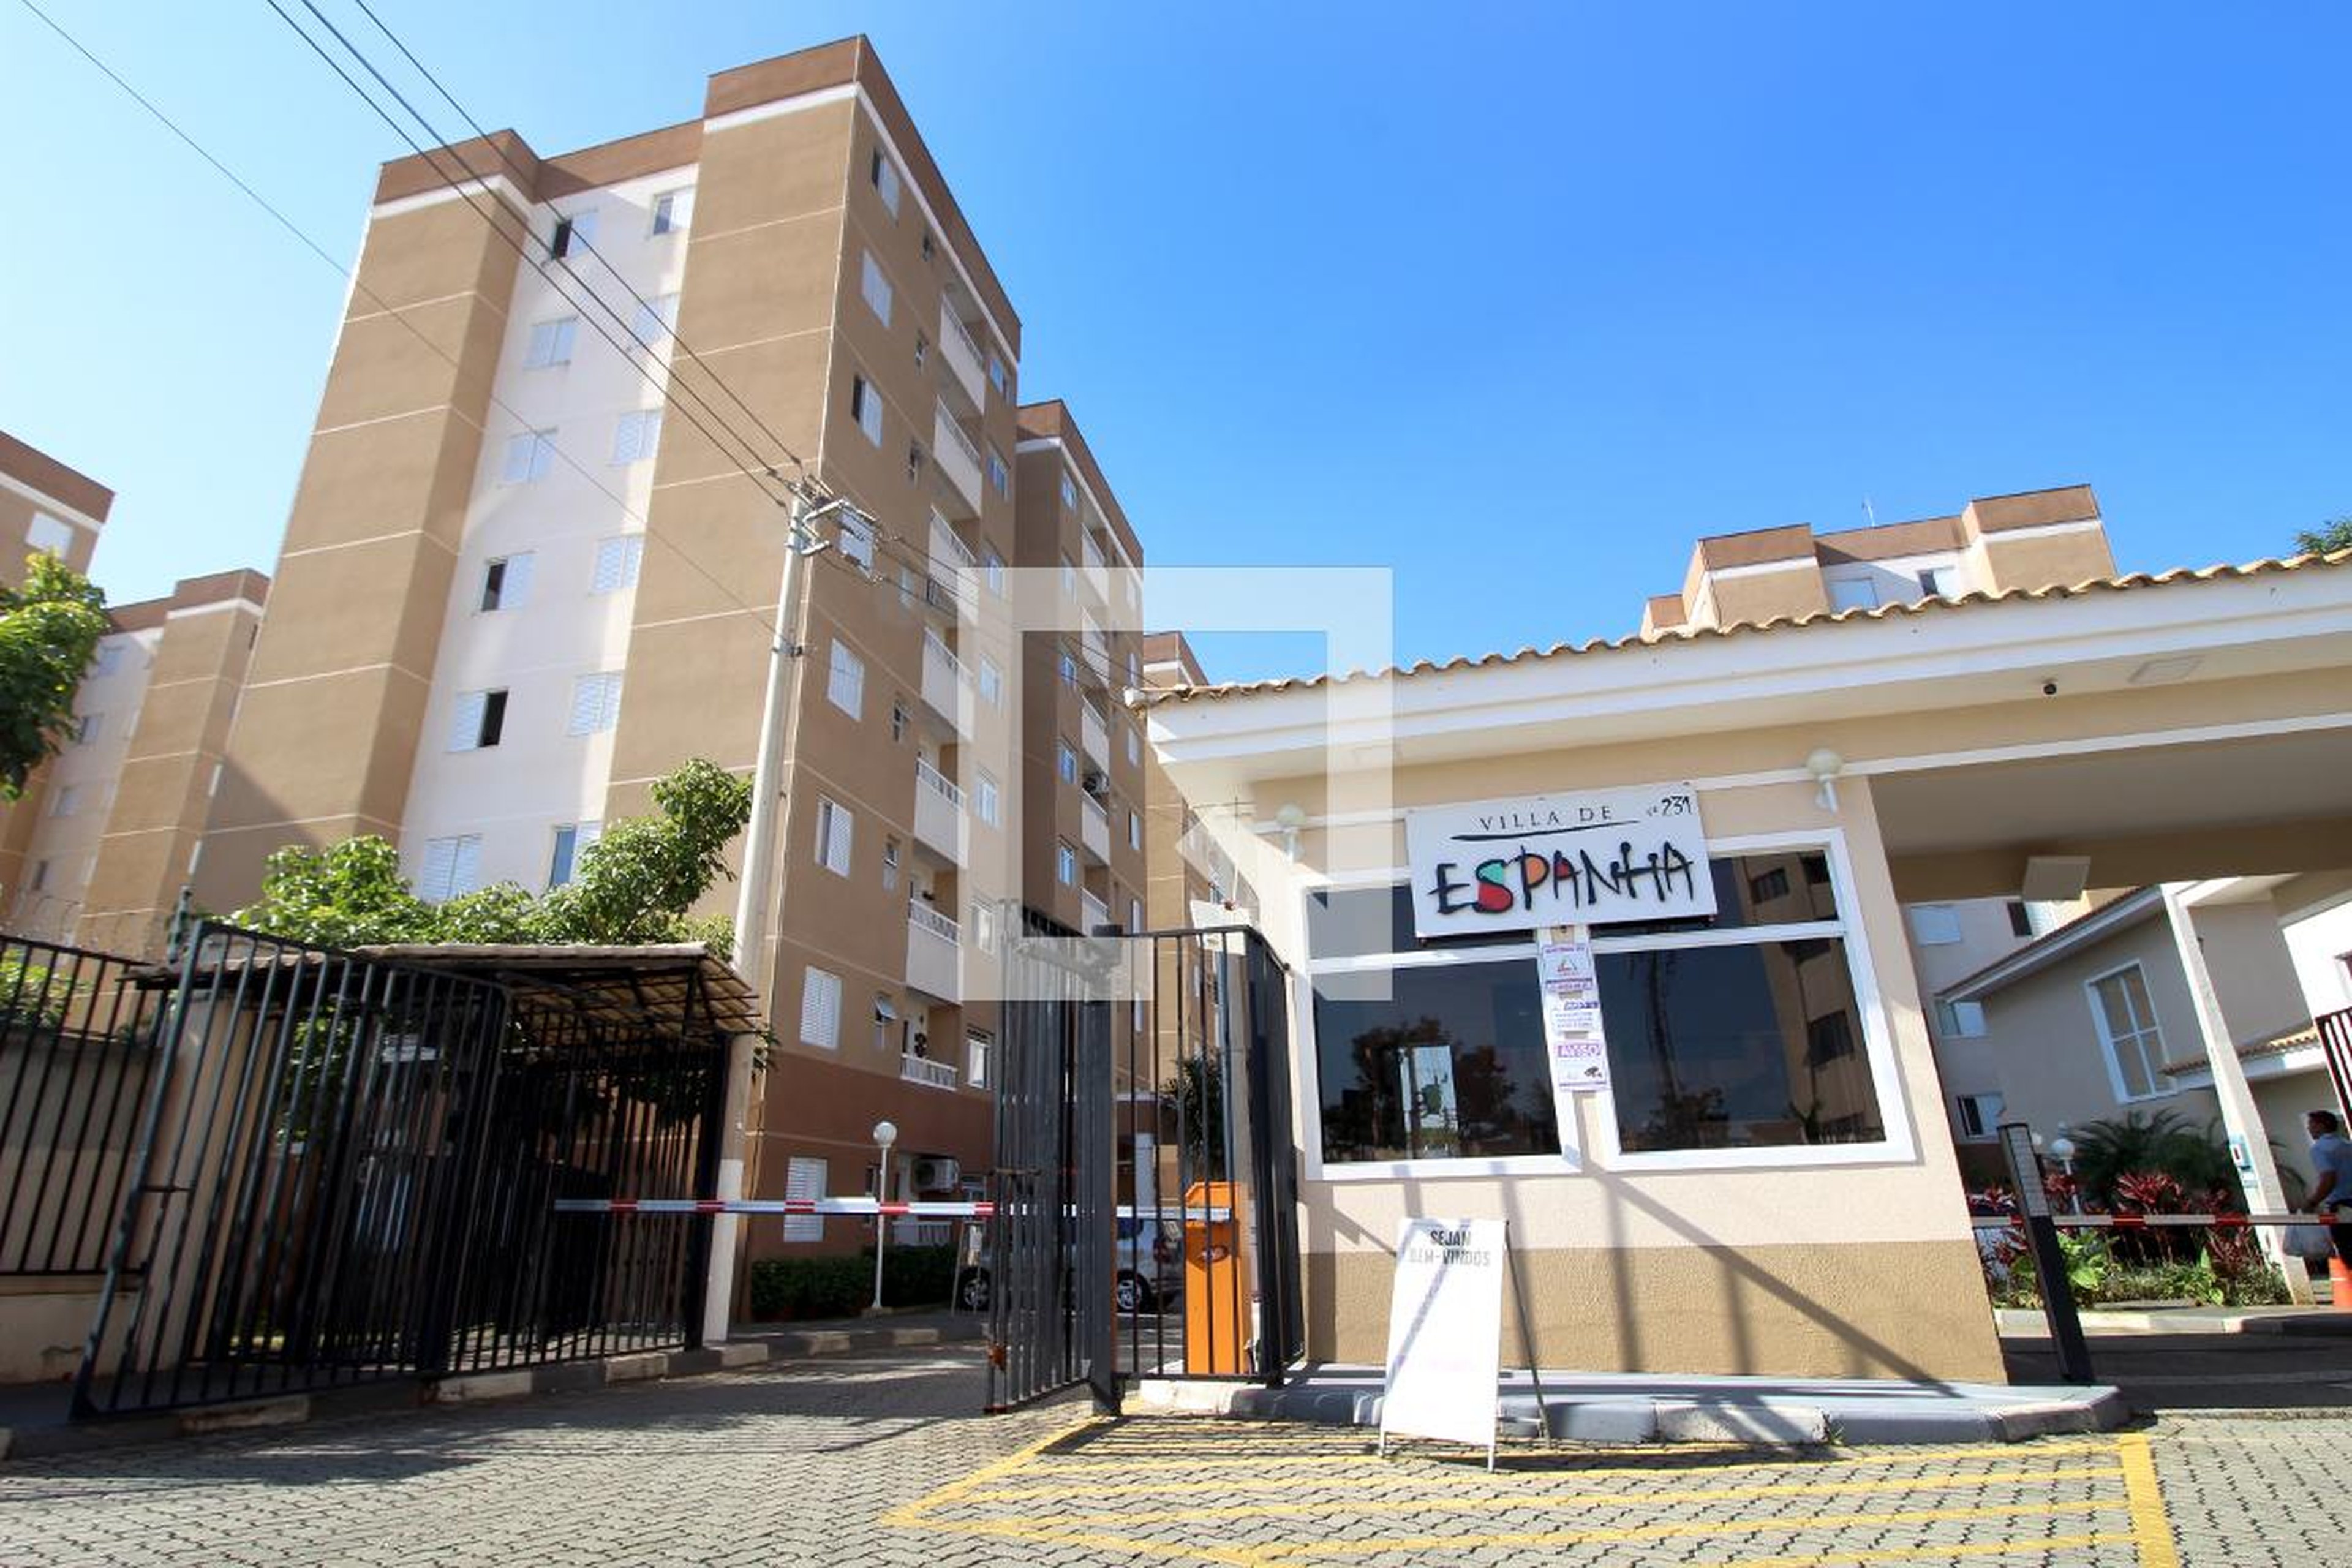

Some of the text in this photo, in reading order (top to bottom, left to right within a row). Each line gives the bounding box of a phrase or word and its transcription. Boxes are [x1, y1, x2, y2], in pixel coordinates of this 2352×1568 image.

[1480, 805, 1612, 831] VILLA DE
[1428, 841, 1694, 915] ESPANHA
